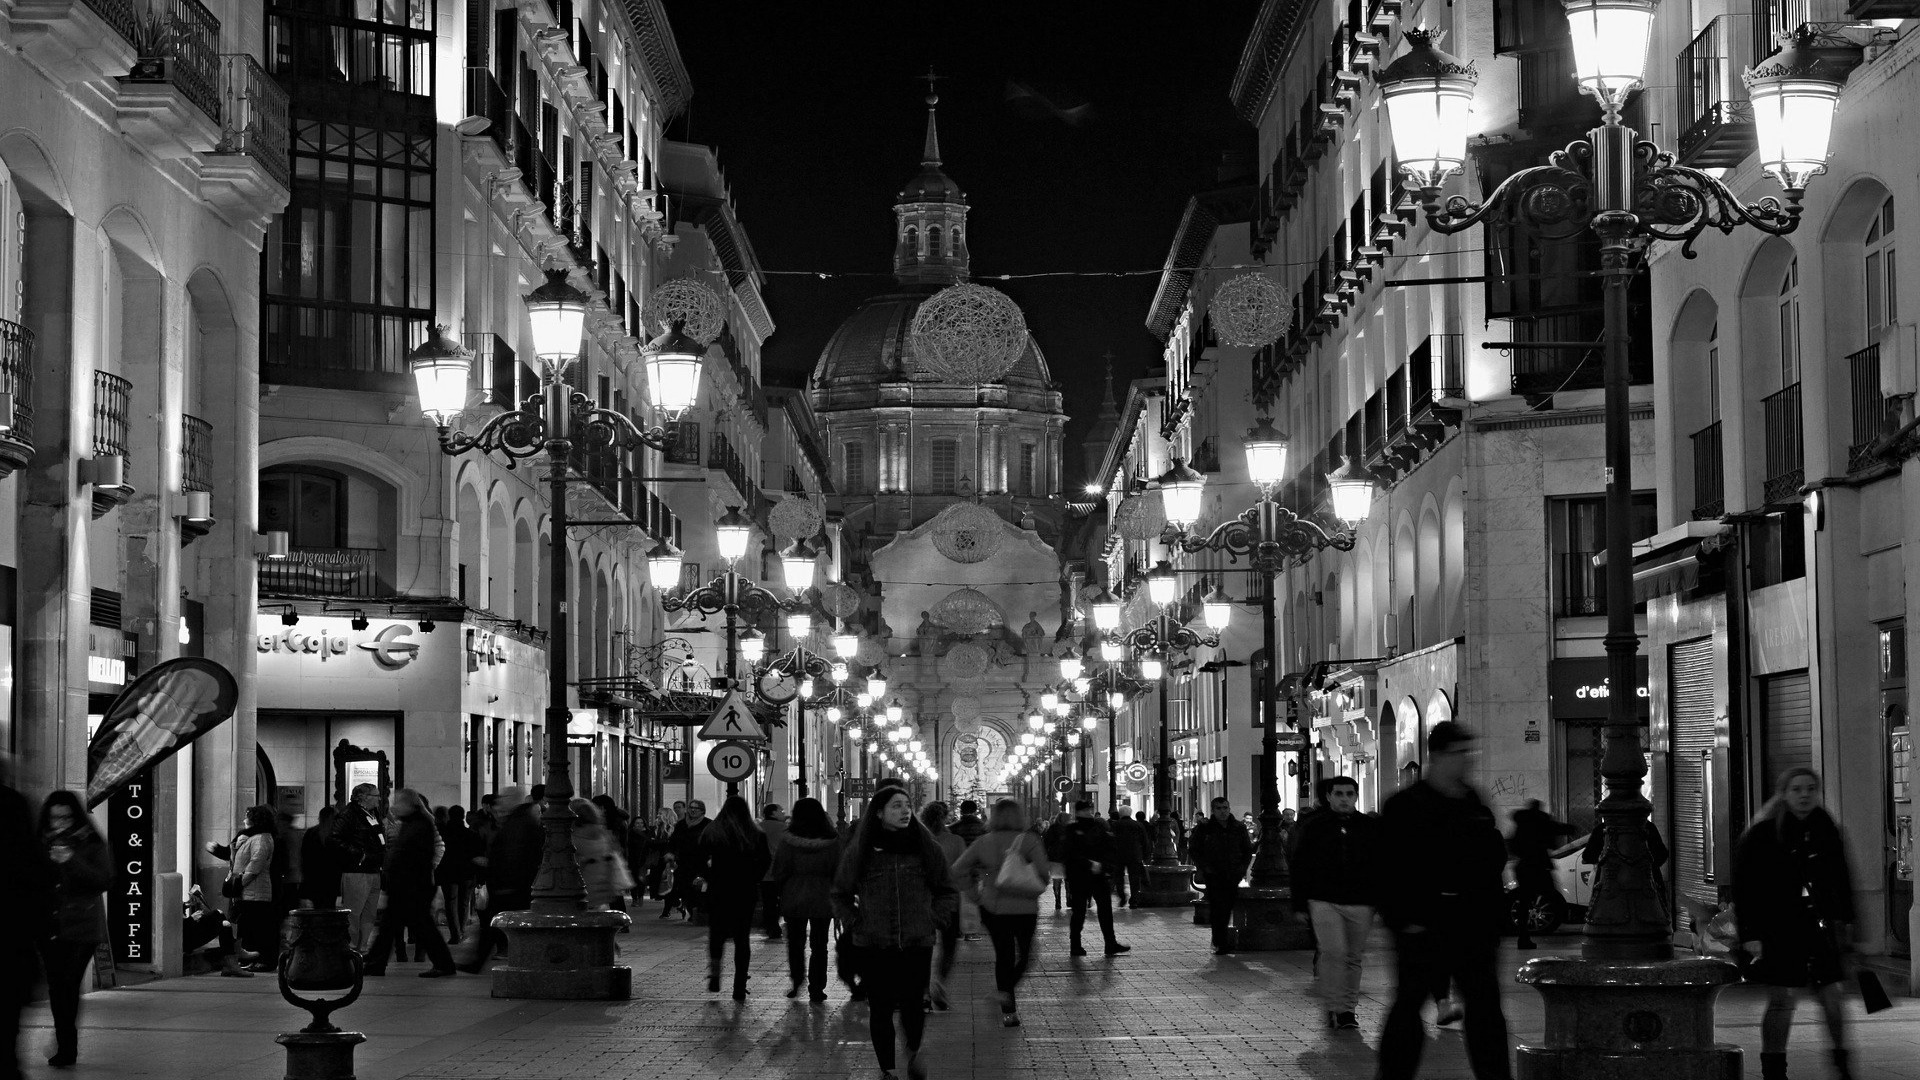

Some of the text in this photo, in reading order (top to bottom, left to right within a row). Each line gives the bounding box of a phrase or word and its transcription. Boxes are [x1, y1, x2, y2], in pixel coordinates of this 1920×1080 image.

[721, 755, 742, 769] 10
[127, 775, 143, 958] TO & CAFFÈ
